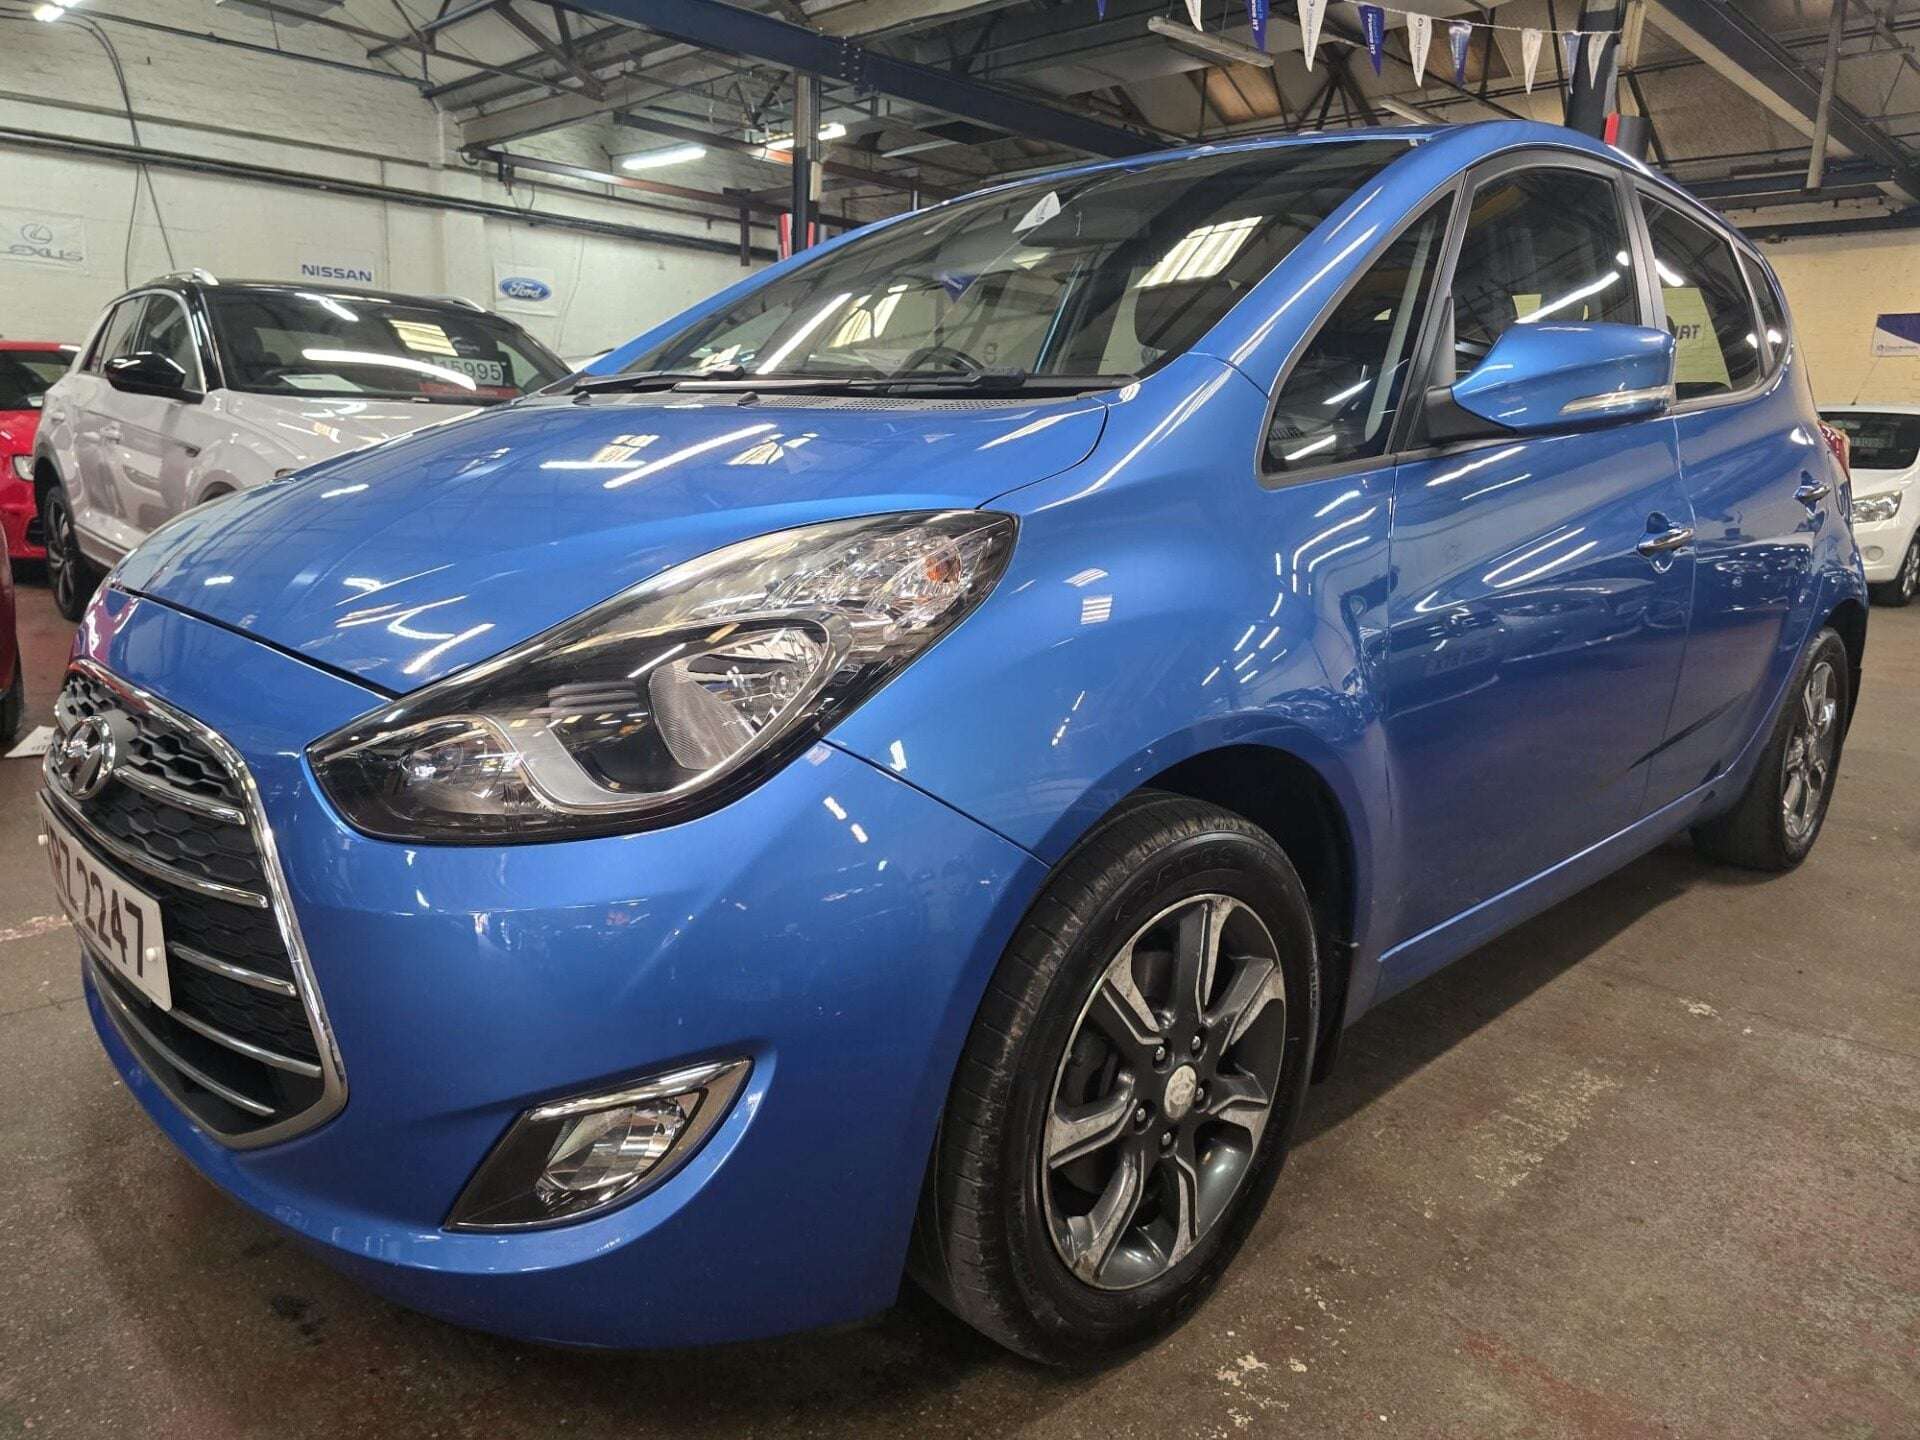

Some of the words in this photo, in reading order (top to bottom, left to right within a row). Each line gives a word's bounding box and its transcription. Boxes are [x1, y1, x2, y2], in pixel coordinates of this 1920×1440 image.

[301, 264, 372, 282] NISSAN
[507, 279, 543, 298] Ford
[76, 856, 144, 979] 2247
